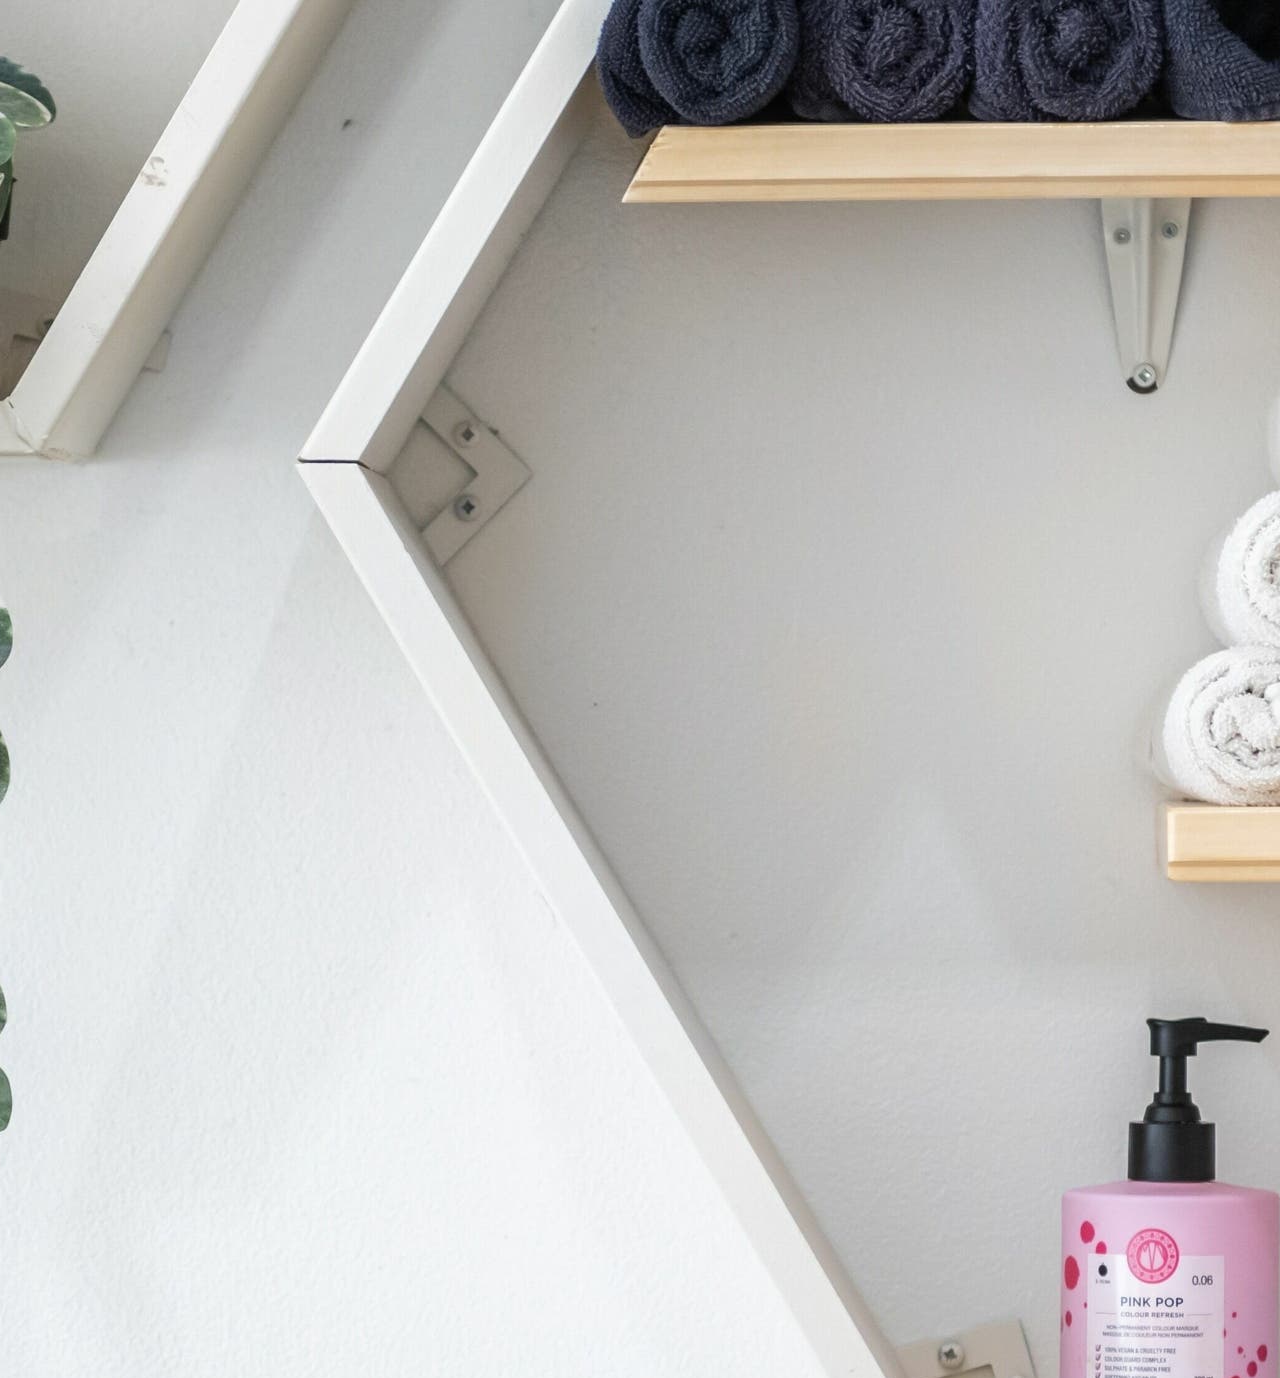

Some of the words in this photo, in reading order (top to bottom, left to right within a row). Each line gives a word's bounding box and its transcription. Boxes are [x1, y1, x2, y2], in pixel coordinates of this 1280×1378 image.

[1192, 1276, 1213, 1285] 0.06
[1120, 1297, 1150, 1307] PINK
[1156, 1297, 1183, 1307] POP
